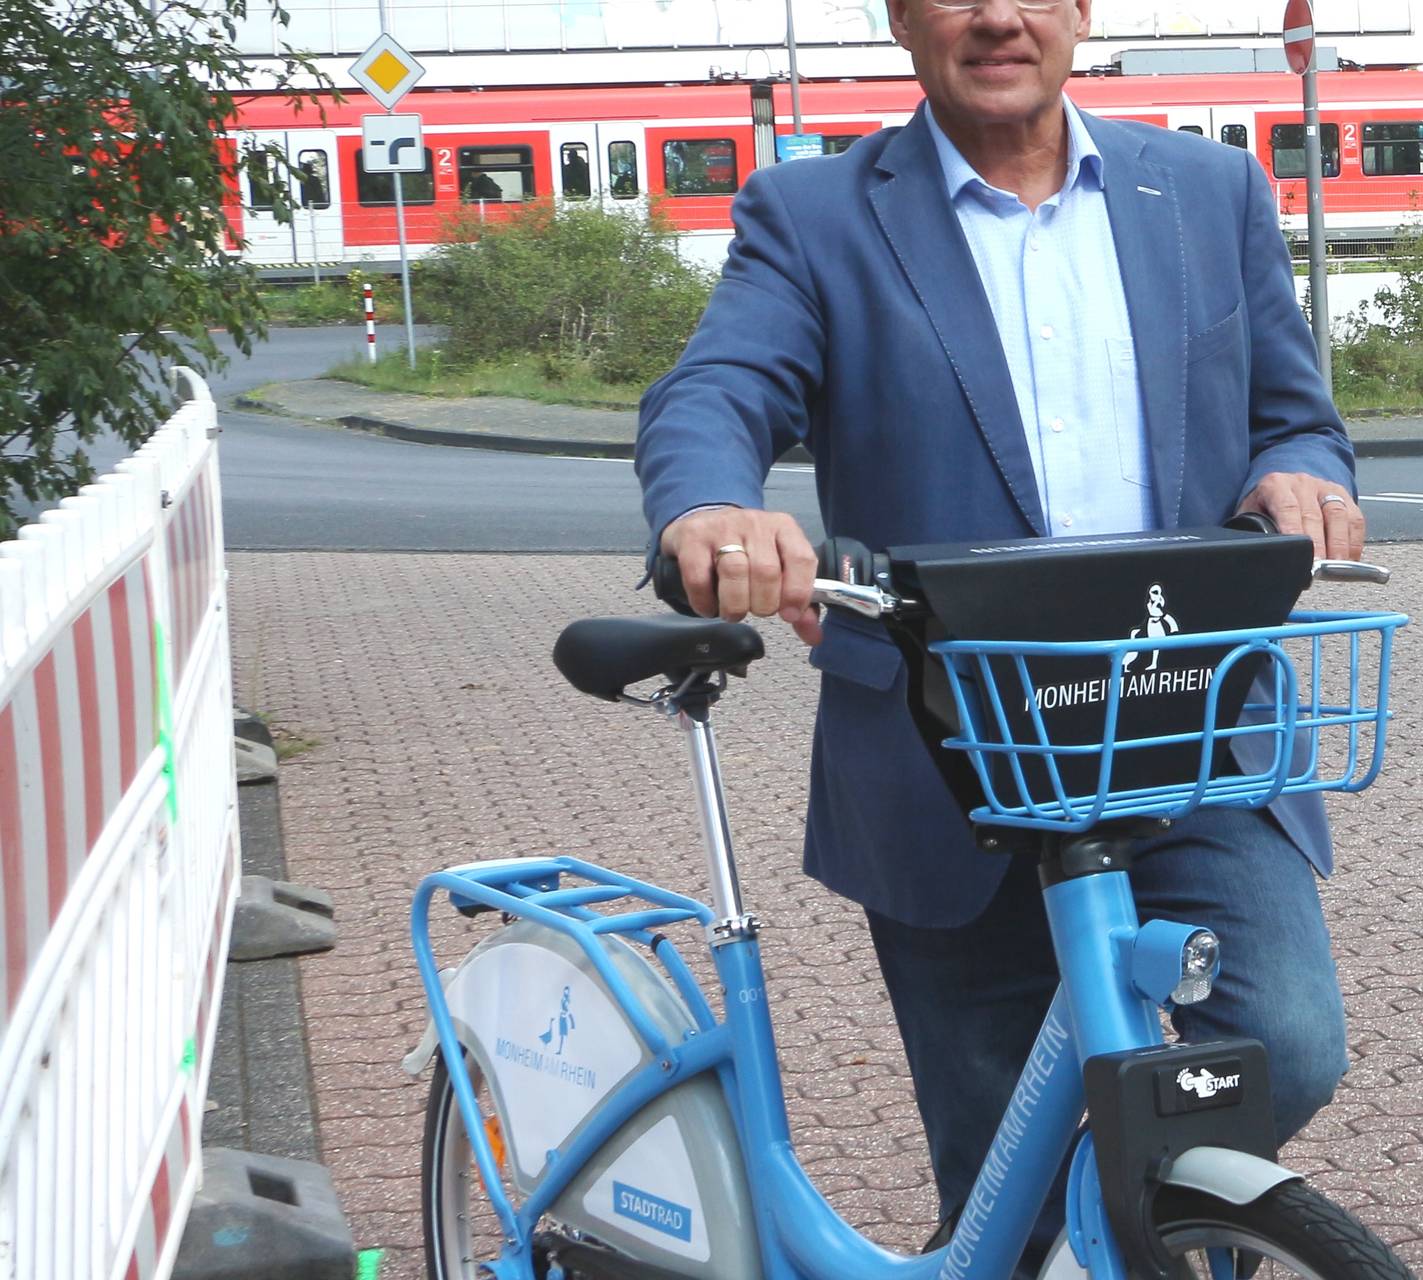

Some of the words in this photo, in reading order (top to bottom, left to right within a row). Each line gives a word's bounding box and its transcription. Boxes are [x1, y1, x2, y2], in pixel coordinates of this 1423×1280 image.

[1344, 124, 1356, 141] 2
[438, 149, 452, 166] 2
[1206, 1074, 1240, 1091] START
[620, 1191, 684, 1230] STADTRAD
